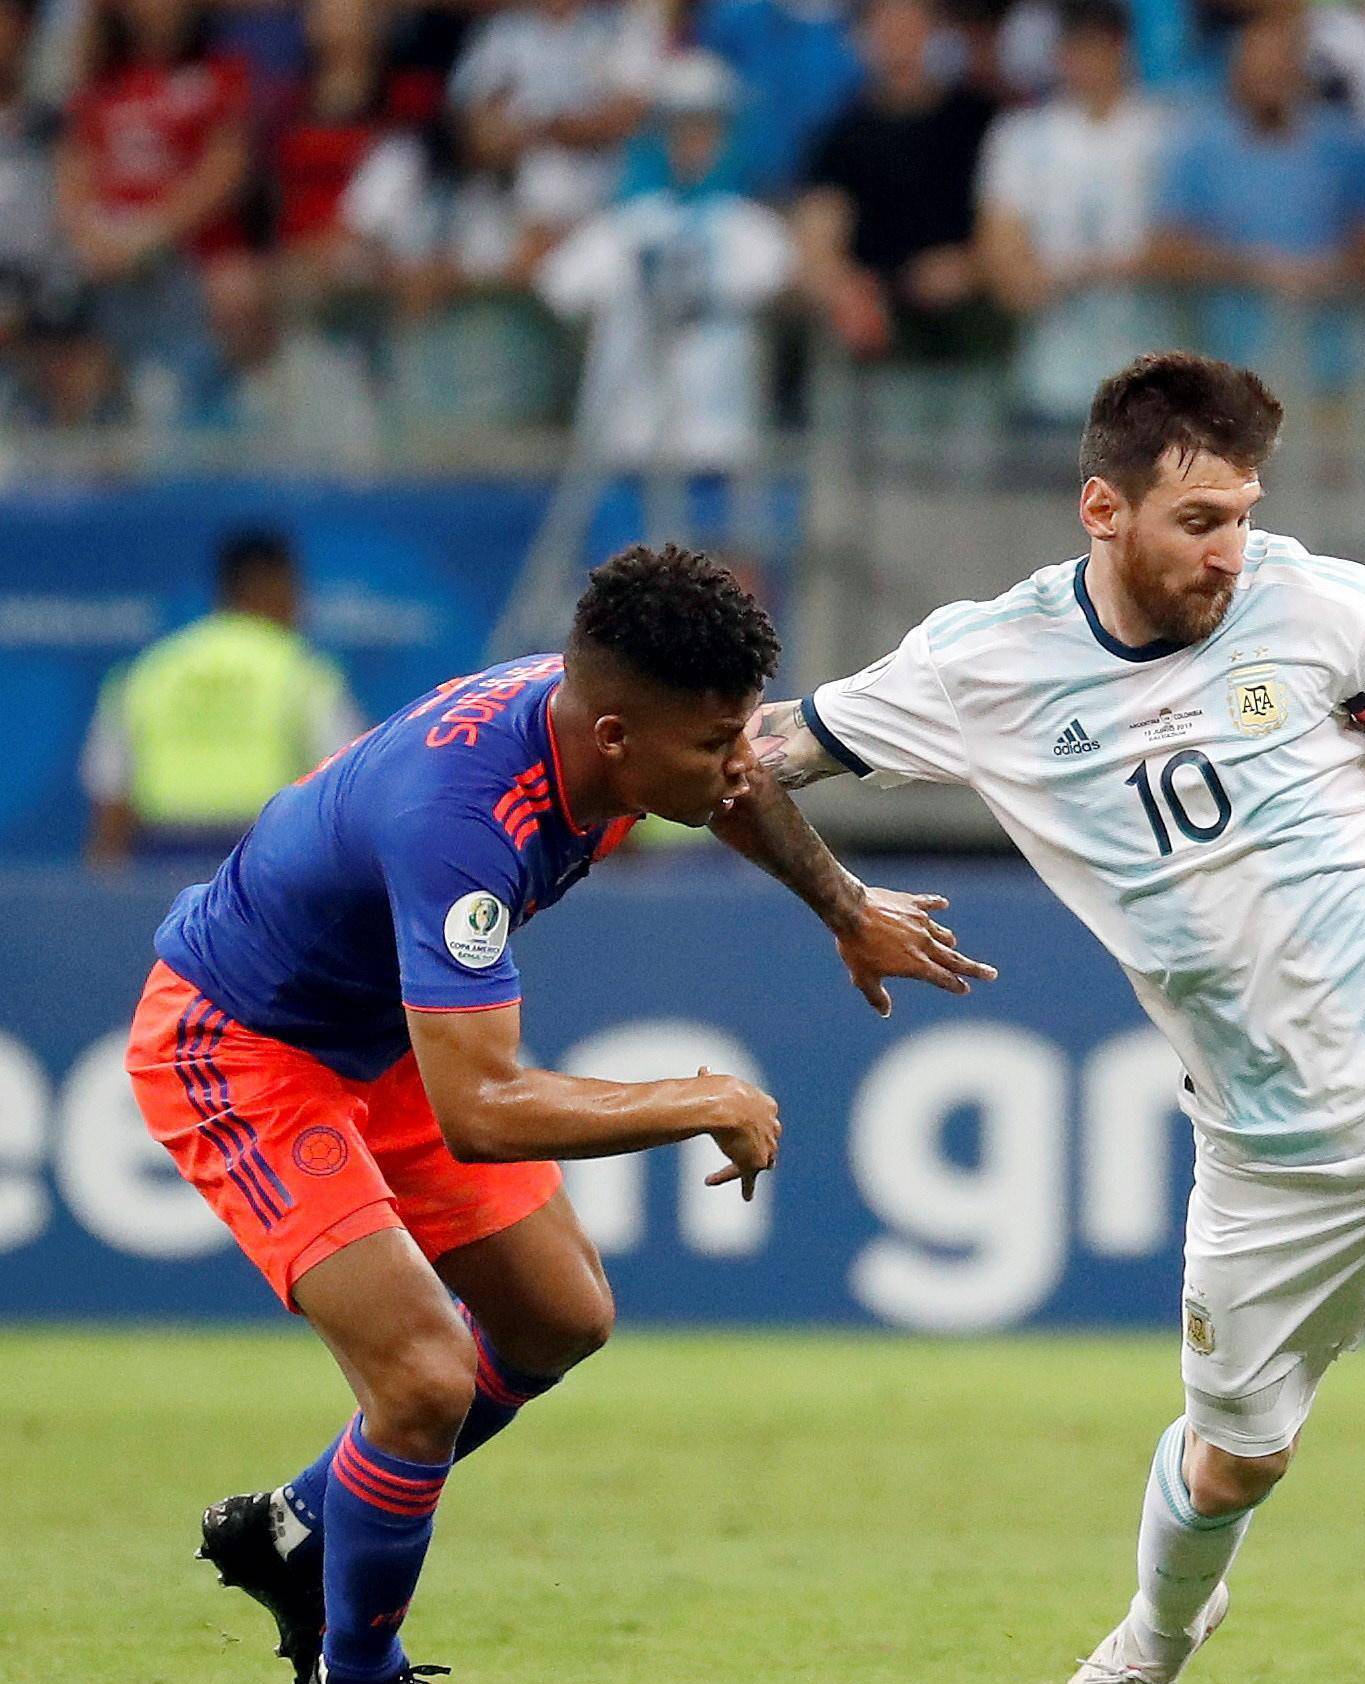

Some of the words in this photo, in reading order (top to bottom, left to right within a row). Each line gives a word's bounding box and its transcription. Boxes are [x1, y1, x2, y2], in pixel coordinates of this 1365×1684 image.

[1241, 685, 1274, 716] AFA
[1053, 739, 1101, 756] adidas
[1123, 749, 1232, 857] 10
